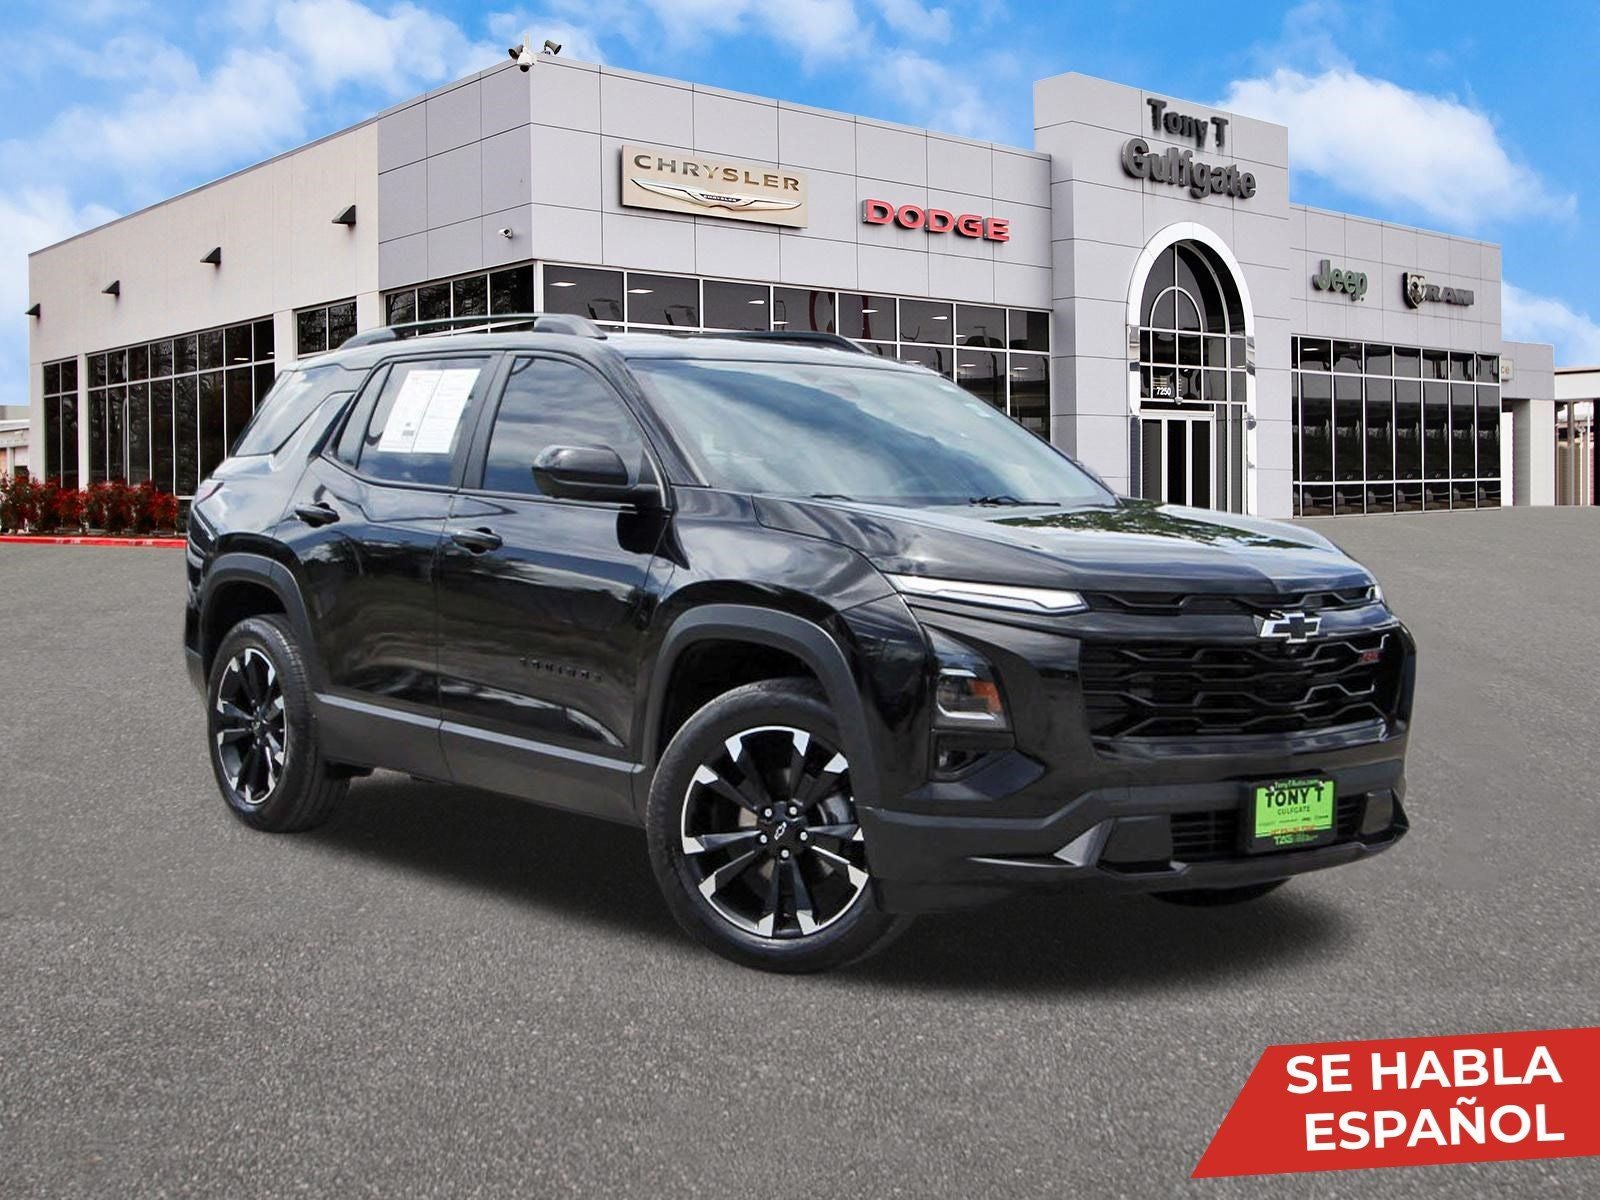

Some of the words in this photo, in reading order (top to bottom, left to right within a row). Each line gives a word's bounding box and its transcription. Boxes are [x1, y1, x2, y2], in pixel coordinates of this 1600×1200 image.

[1146, 98, 1208, 148] Tony
[1211, 117, 1229, 147] T
[633, 154, 800, 192] CHRYSLER
[1121, 138, 1257, 199] Gulfgate
[863, 199, 1010, 242] DODGE
[1312, 260, 1368, 301] Jeep
[1425, 284, 1474, 306] RAM
[1156, 386, 1172, 396] 7250
[1265, 787, 1310, 808] TONY
[1315, 786, 1324, 802] T
